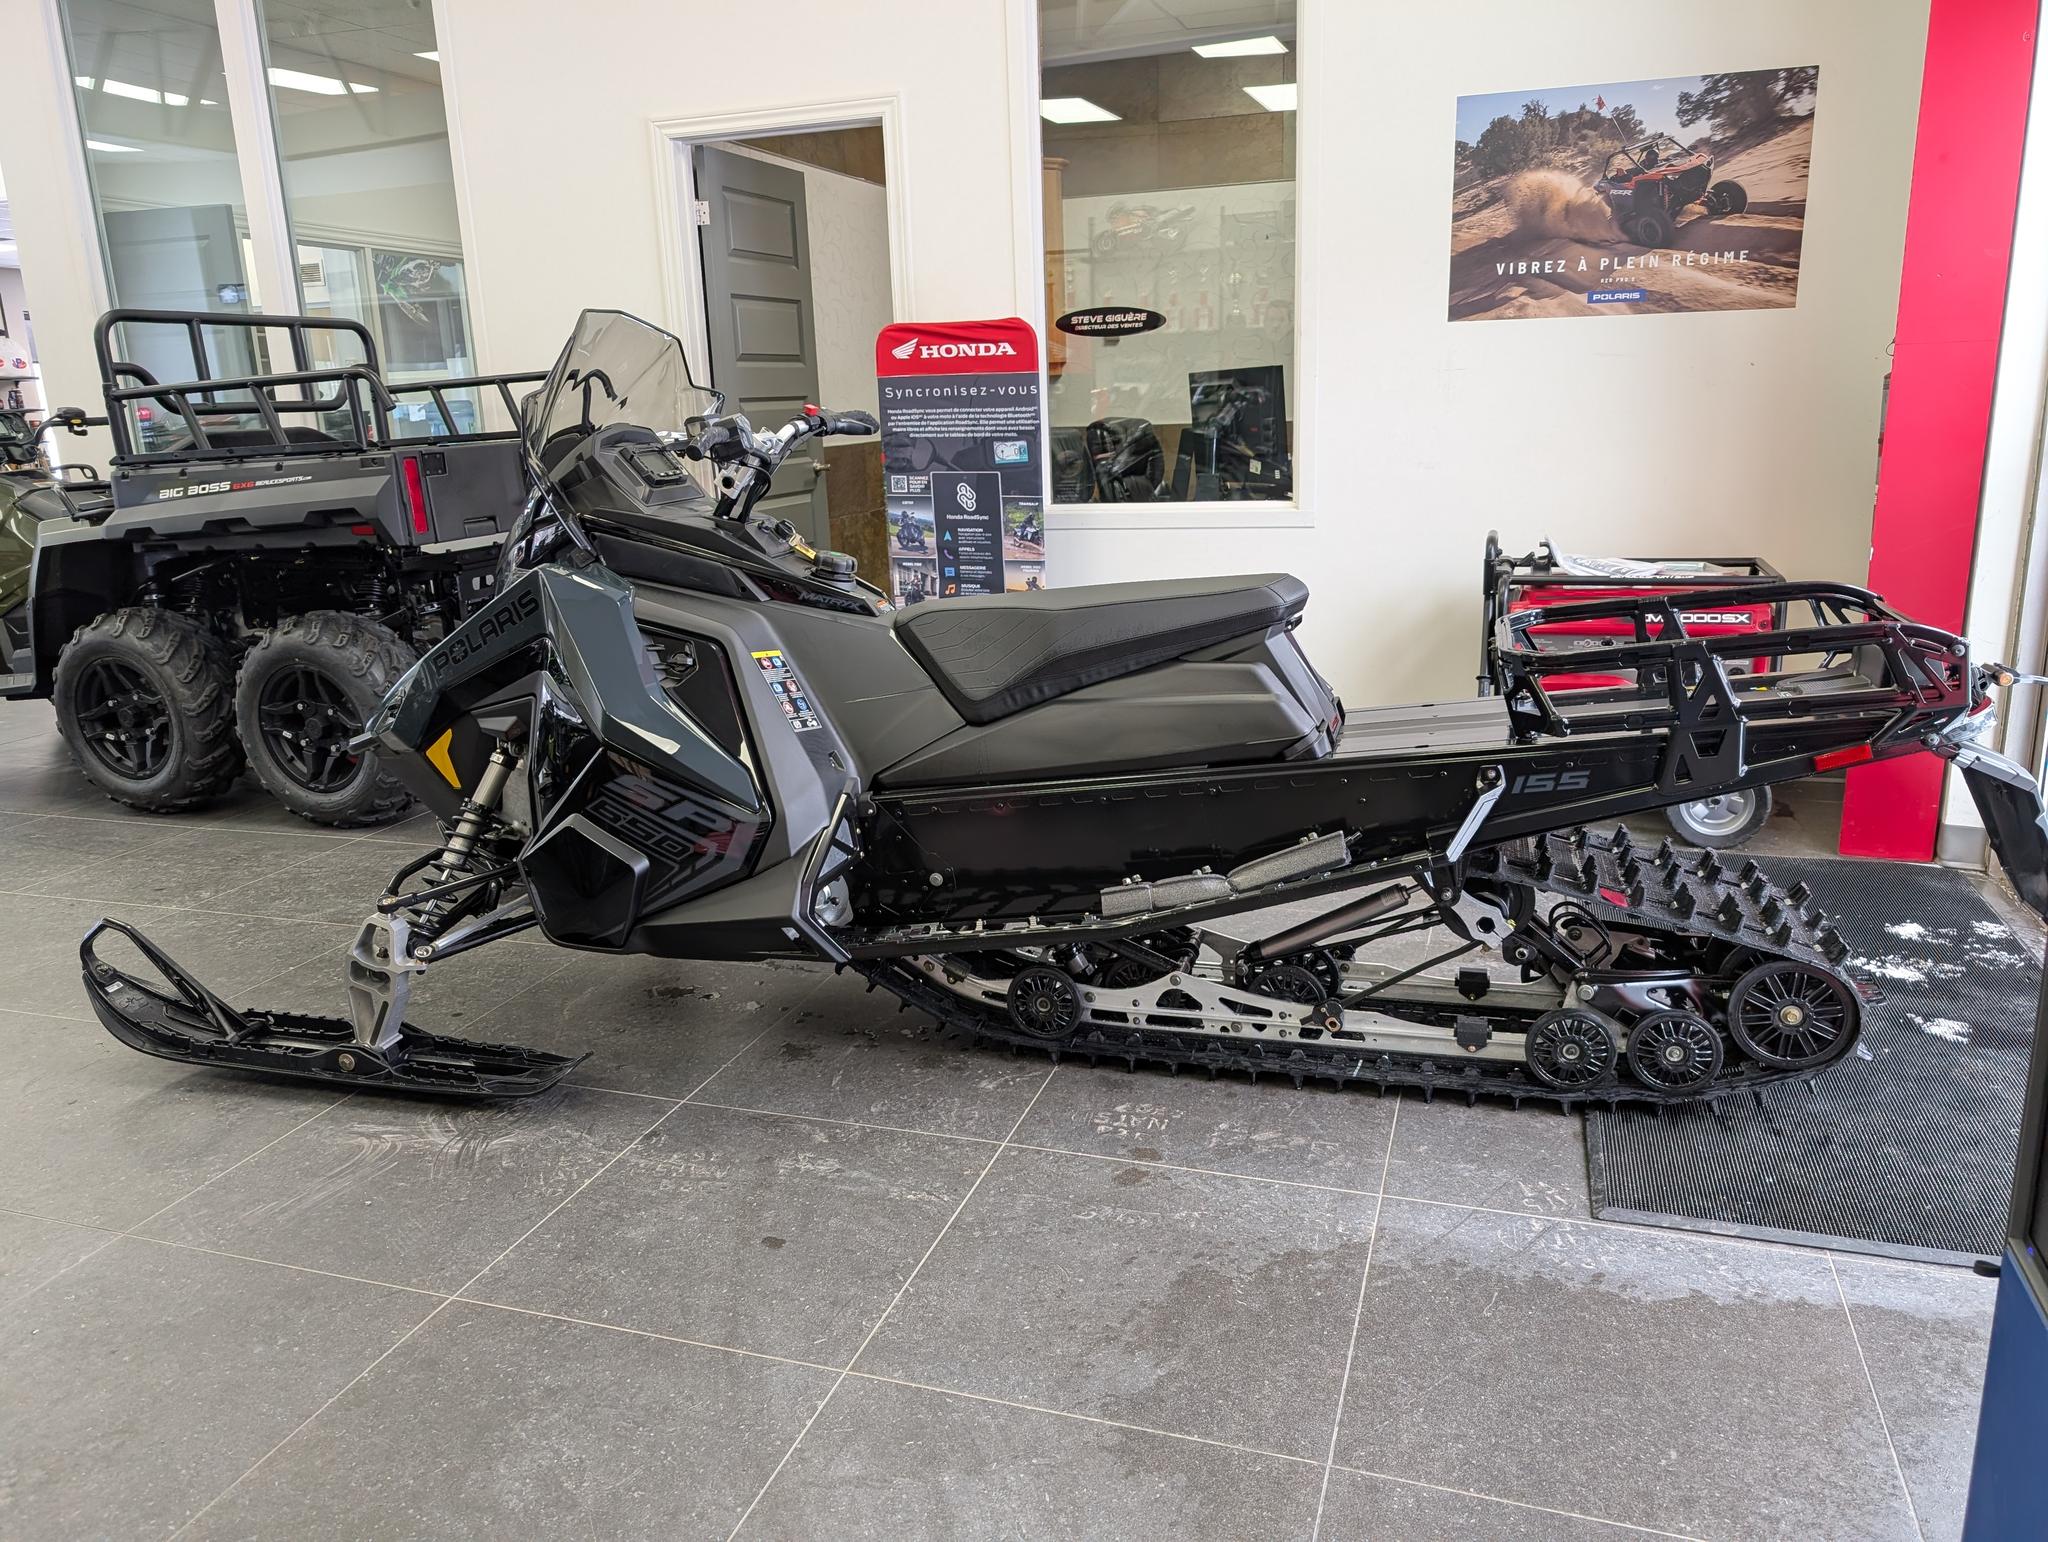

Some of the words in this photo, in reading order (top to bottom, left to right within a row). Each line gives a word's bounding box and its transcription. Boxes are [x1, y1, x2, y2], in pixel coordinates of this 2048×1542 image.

[1496, 260, 1566, 276] VIBREZ
[1578, 256, 1588, 272] À
[1600, 255, 1659, 271] PLEIN
[1672, 250, 1749, 266] RÉGIME
[1592, 292, 1640, 300] POLARIS
[1070, 315, 1104, 324] STEVE
[1105, 312, 1148, 322] GIGUÈRE
[920, 342, 1016, 358] HONDA
[885, 385, 1038, 400] Syncronisez-vous
[160, 488, 184, 499] BIG
[187, 481, 231, 495] BOSS
[798, 591, 861, 612] MATRYX
[1644, 614, 1750, 623] M000SX
[433, 590, 540, 677] POLARIS
[1512, 770, 1591, 794] 155
[586, 797, 694, 860] 650
